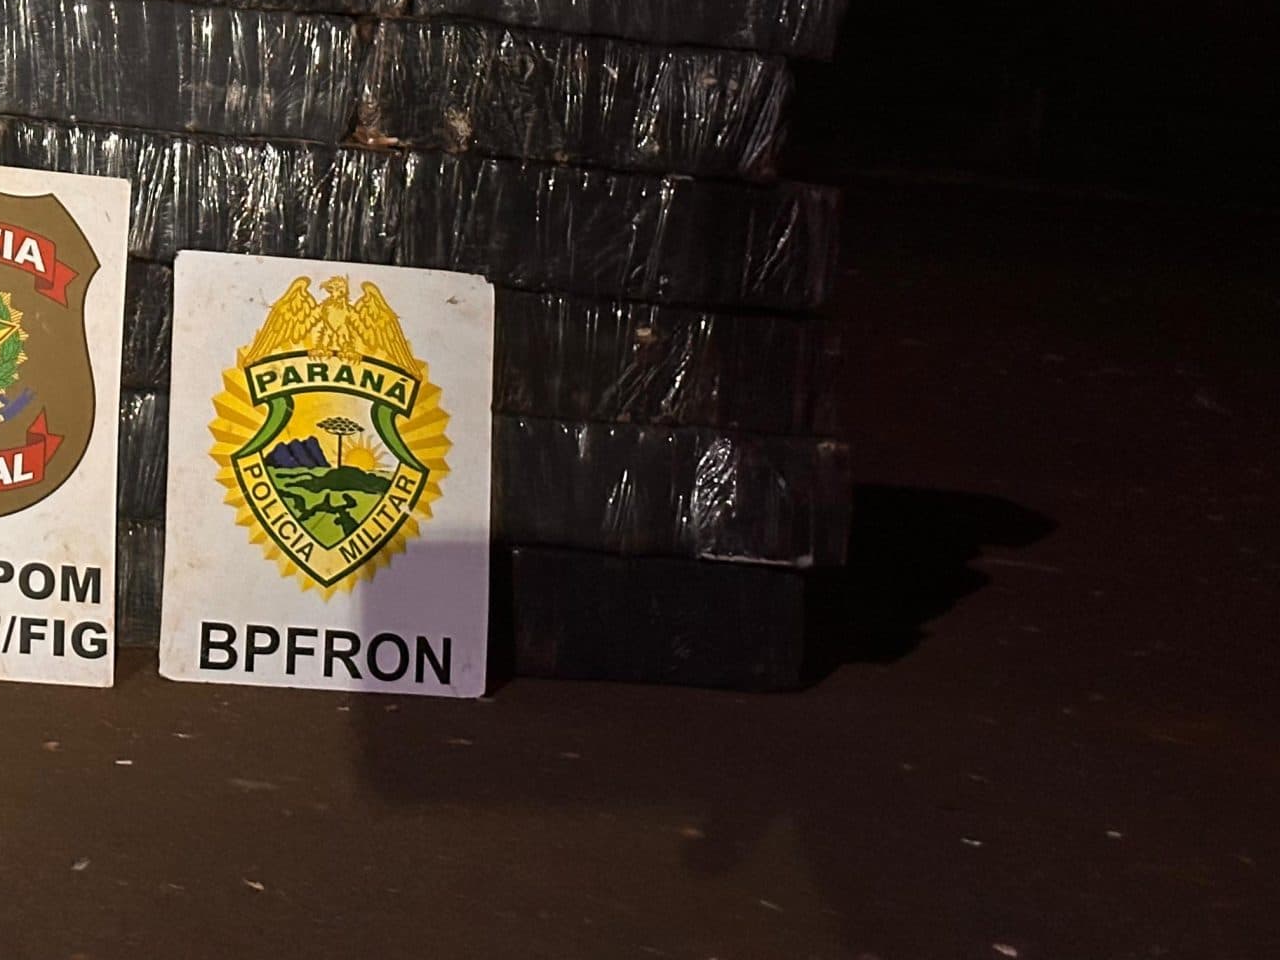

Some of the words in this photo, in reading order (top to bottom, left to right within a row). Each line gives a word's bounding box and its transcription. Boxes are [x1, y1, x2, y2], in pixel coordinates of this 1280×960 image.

[255, 361, 409, 406] PARANÁ
[242, 463, 314, 563] POLÍCIA
[340, 473, 417, 566] MILITAR
[199, 621, 453, 685] BPFRON
